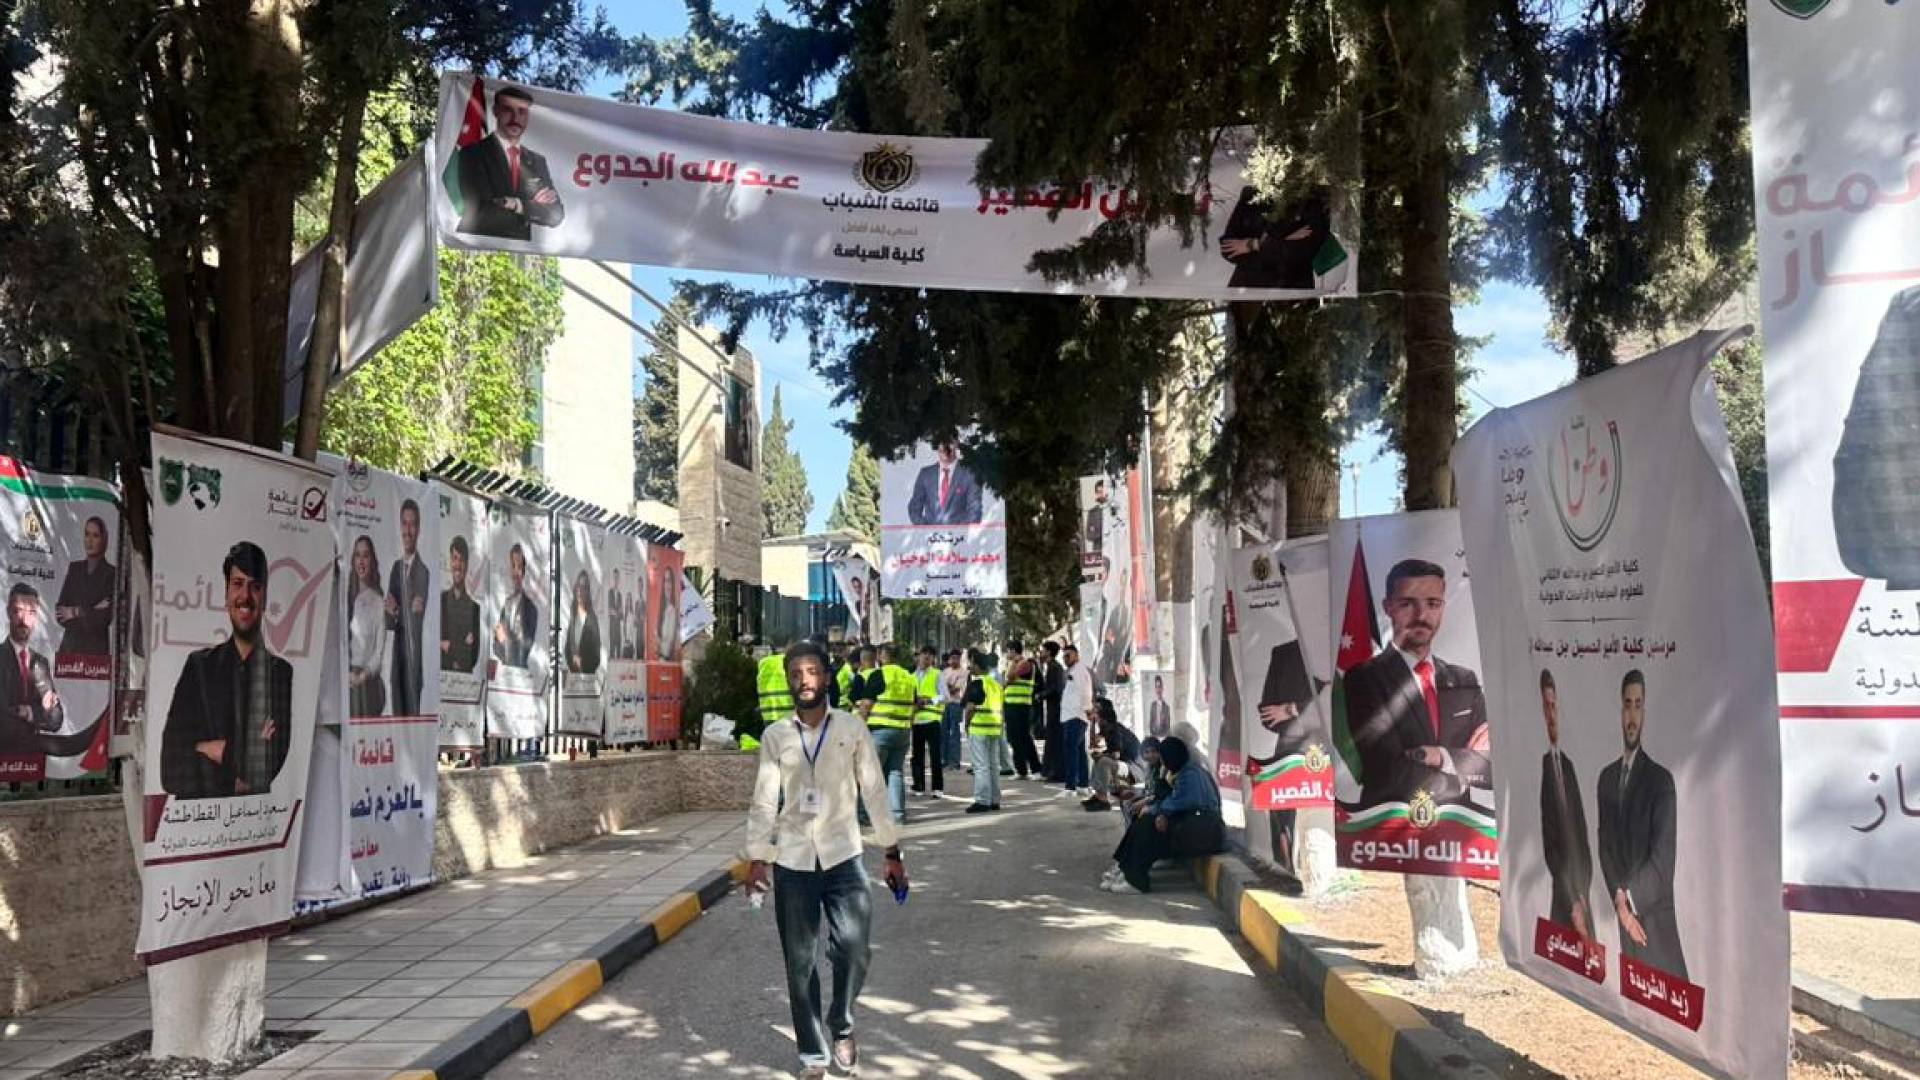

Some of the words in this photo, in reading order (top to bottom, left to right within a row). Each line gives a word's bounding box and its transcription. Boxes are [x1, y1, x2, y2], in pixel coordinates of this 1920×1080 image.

[572, 151, 676, 187] الجدوع
[680, 159, 736, 185] الله
[739, 166, 800, 195] عبد
[822, 191, 888, 213] الشباب
[891, 196, 939, 213] قائمة
[833, 243, 889, 263] السياسة
[892, 246, 925, 265] كلية
[155, 573, 229, 611] ائمة
[1855, 667, 1920, 696] دولية
[1271, 781, 1322, 805] القصير
[1351, 839, 1419, 864] الجدوع
[1424, 841, 1462, 864] الله
[1466, 846, 1499, 870] بد
